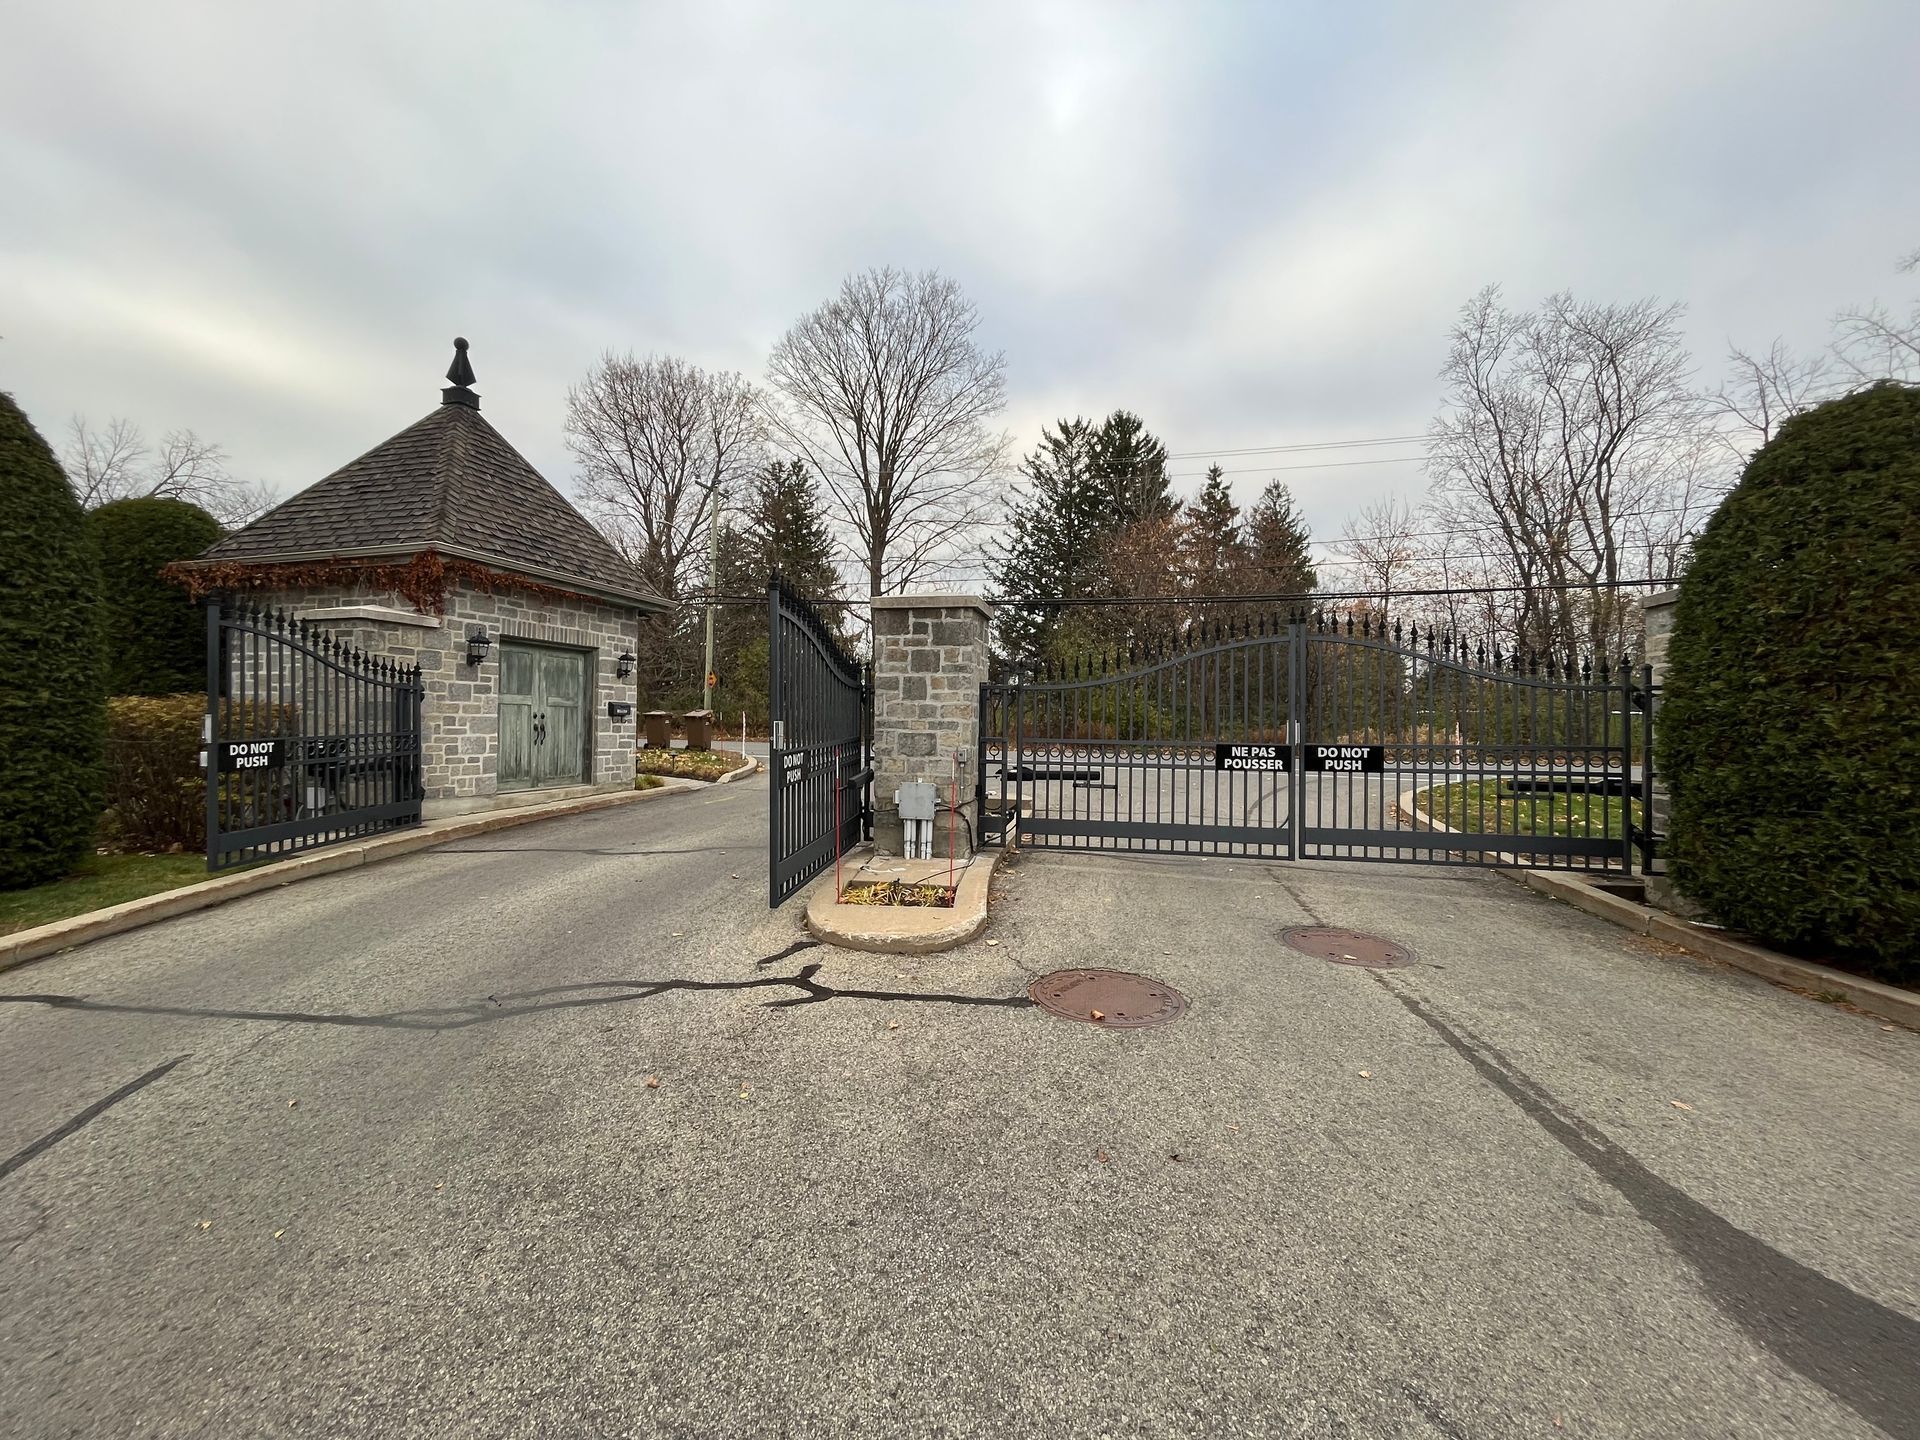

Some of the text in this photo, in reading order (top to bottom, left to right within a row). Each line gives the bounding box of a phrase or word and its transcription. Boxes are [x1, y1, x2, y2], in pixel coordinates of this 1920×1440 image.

[229, 742, 275, 756] DO NOT
[1231, 746, 1276, 757] NE PAS
[1317, 747, 1370, 758] DO NOT
[236, 755, 268, 769] PUSH
[783, 754, 792, 769] DO
[1224, 758, 1283, 770] POUSSER
[1325, 760, 1362, 771] PUSH
